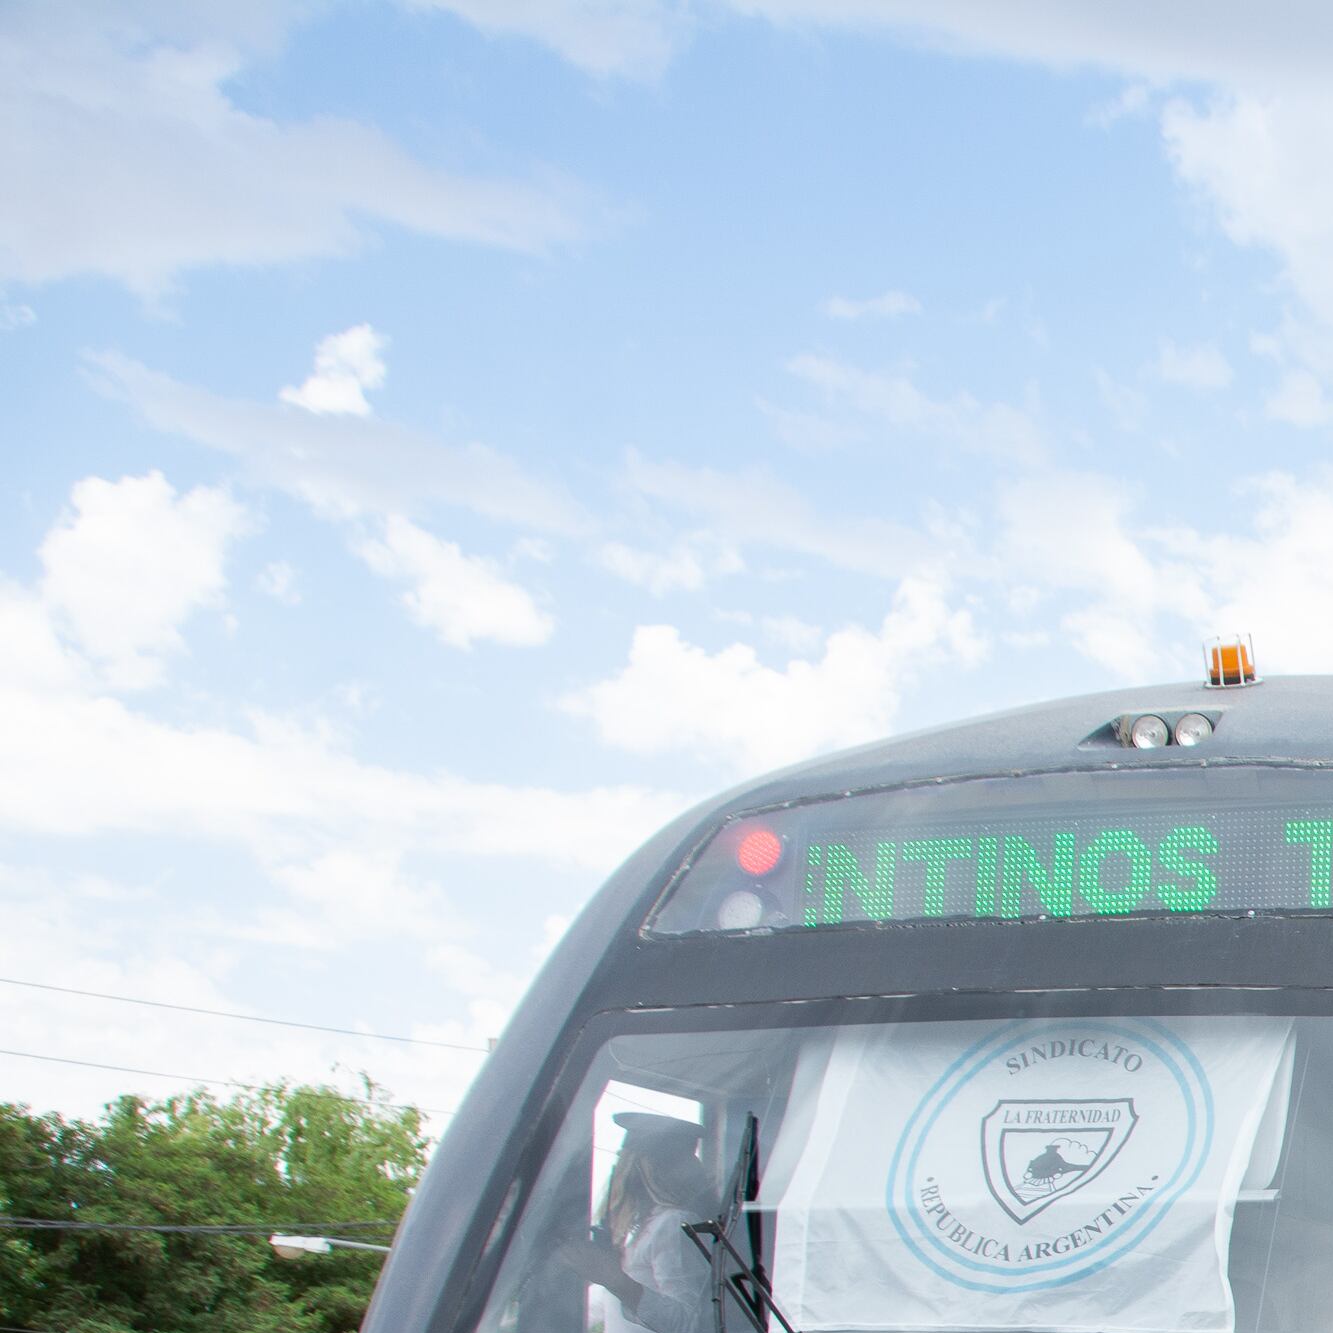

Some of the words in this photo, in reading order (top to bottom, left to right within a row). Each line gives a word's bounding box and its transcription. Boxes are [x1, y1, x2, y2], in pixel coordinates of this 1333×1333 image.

[1006, 1039, 1143, 1075] SINDICATO
[1003, 1109, 1021, 1124] LA
[1025, 1108, 1121, 1124] FRATERNIDAD
[920, 1184, 1010, 1262] REPUBLICA
[1017, 1185, 1153, 1262] ARGENTINA
